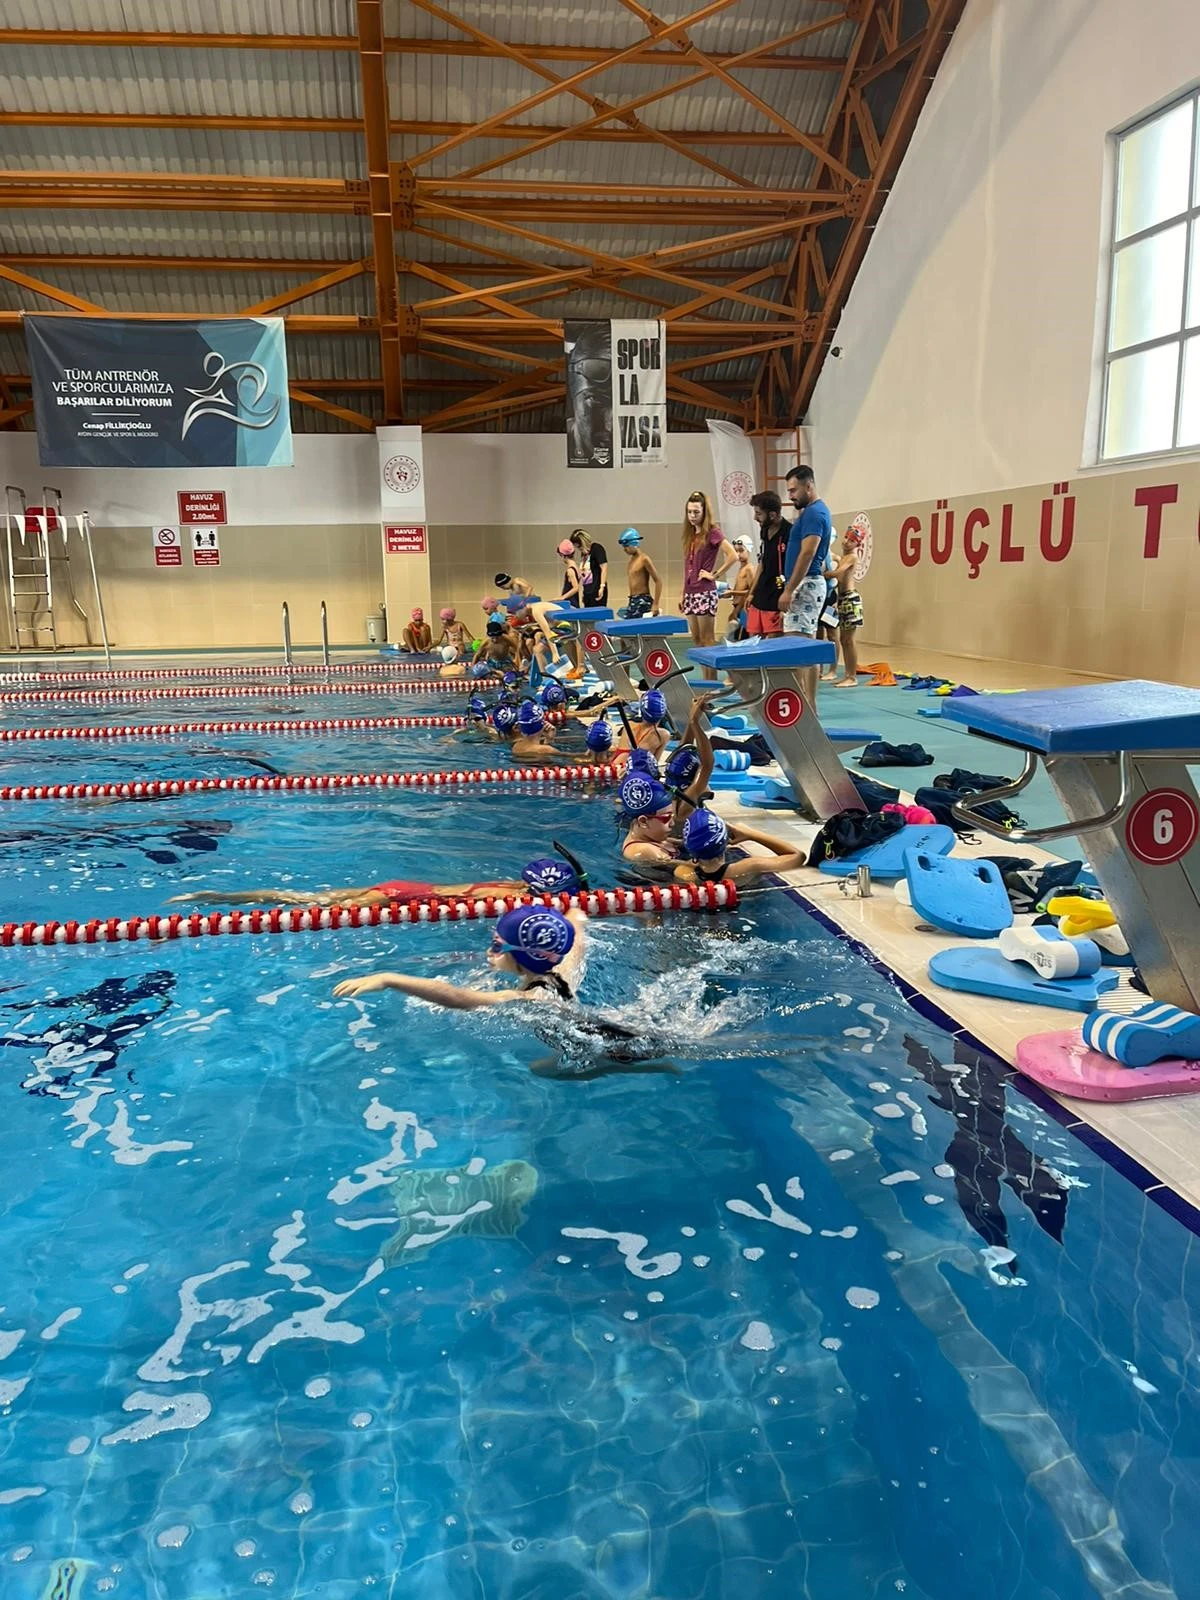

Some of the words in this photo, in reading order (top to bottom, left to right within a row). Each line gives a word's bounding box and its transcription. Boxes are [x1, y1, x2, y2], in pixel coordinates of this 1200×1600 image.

[617, 338, 661, 370] SPOR
[64, 368, 92, 380] TÜM
[95, 369, 159, 381] ANTRENÖR
[52, 382, 68, 392] VE
[70, 382, 174, 394] SPORCULARIMIZA
[619, 374, 640, 405] LA
[56, 396, 114, 407] BAŞARILAR
[115, 396, 172, 407] DİLİYORUM
[82, 422, 104, 430] Cenap
[618, 416, 661, 452] YAŞA
[185, 503, 220, 511] DERİNLİĞİ
[900, 482, 1076, 579] GÜÇLÜ
[1135, 483, 1200, 559] T
[591, 637, 598, 646] 3
[655, 657, 664, 670] 4
[779, 698, 790, 717] 5
[1153, 808, 1174, 845] 6
